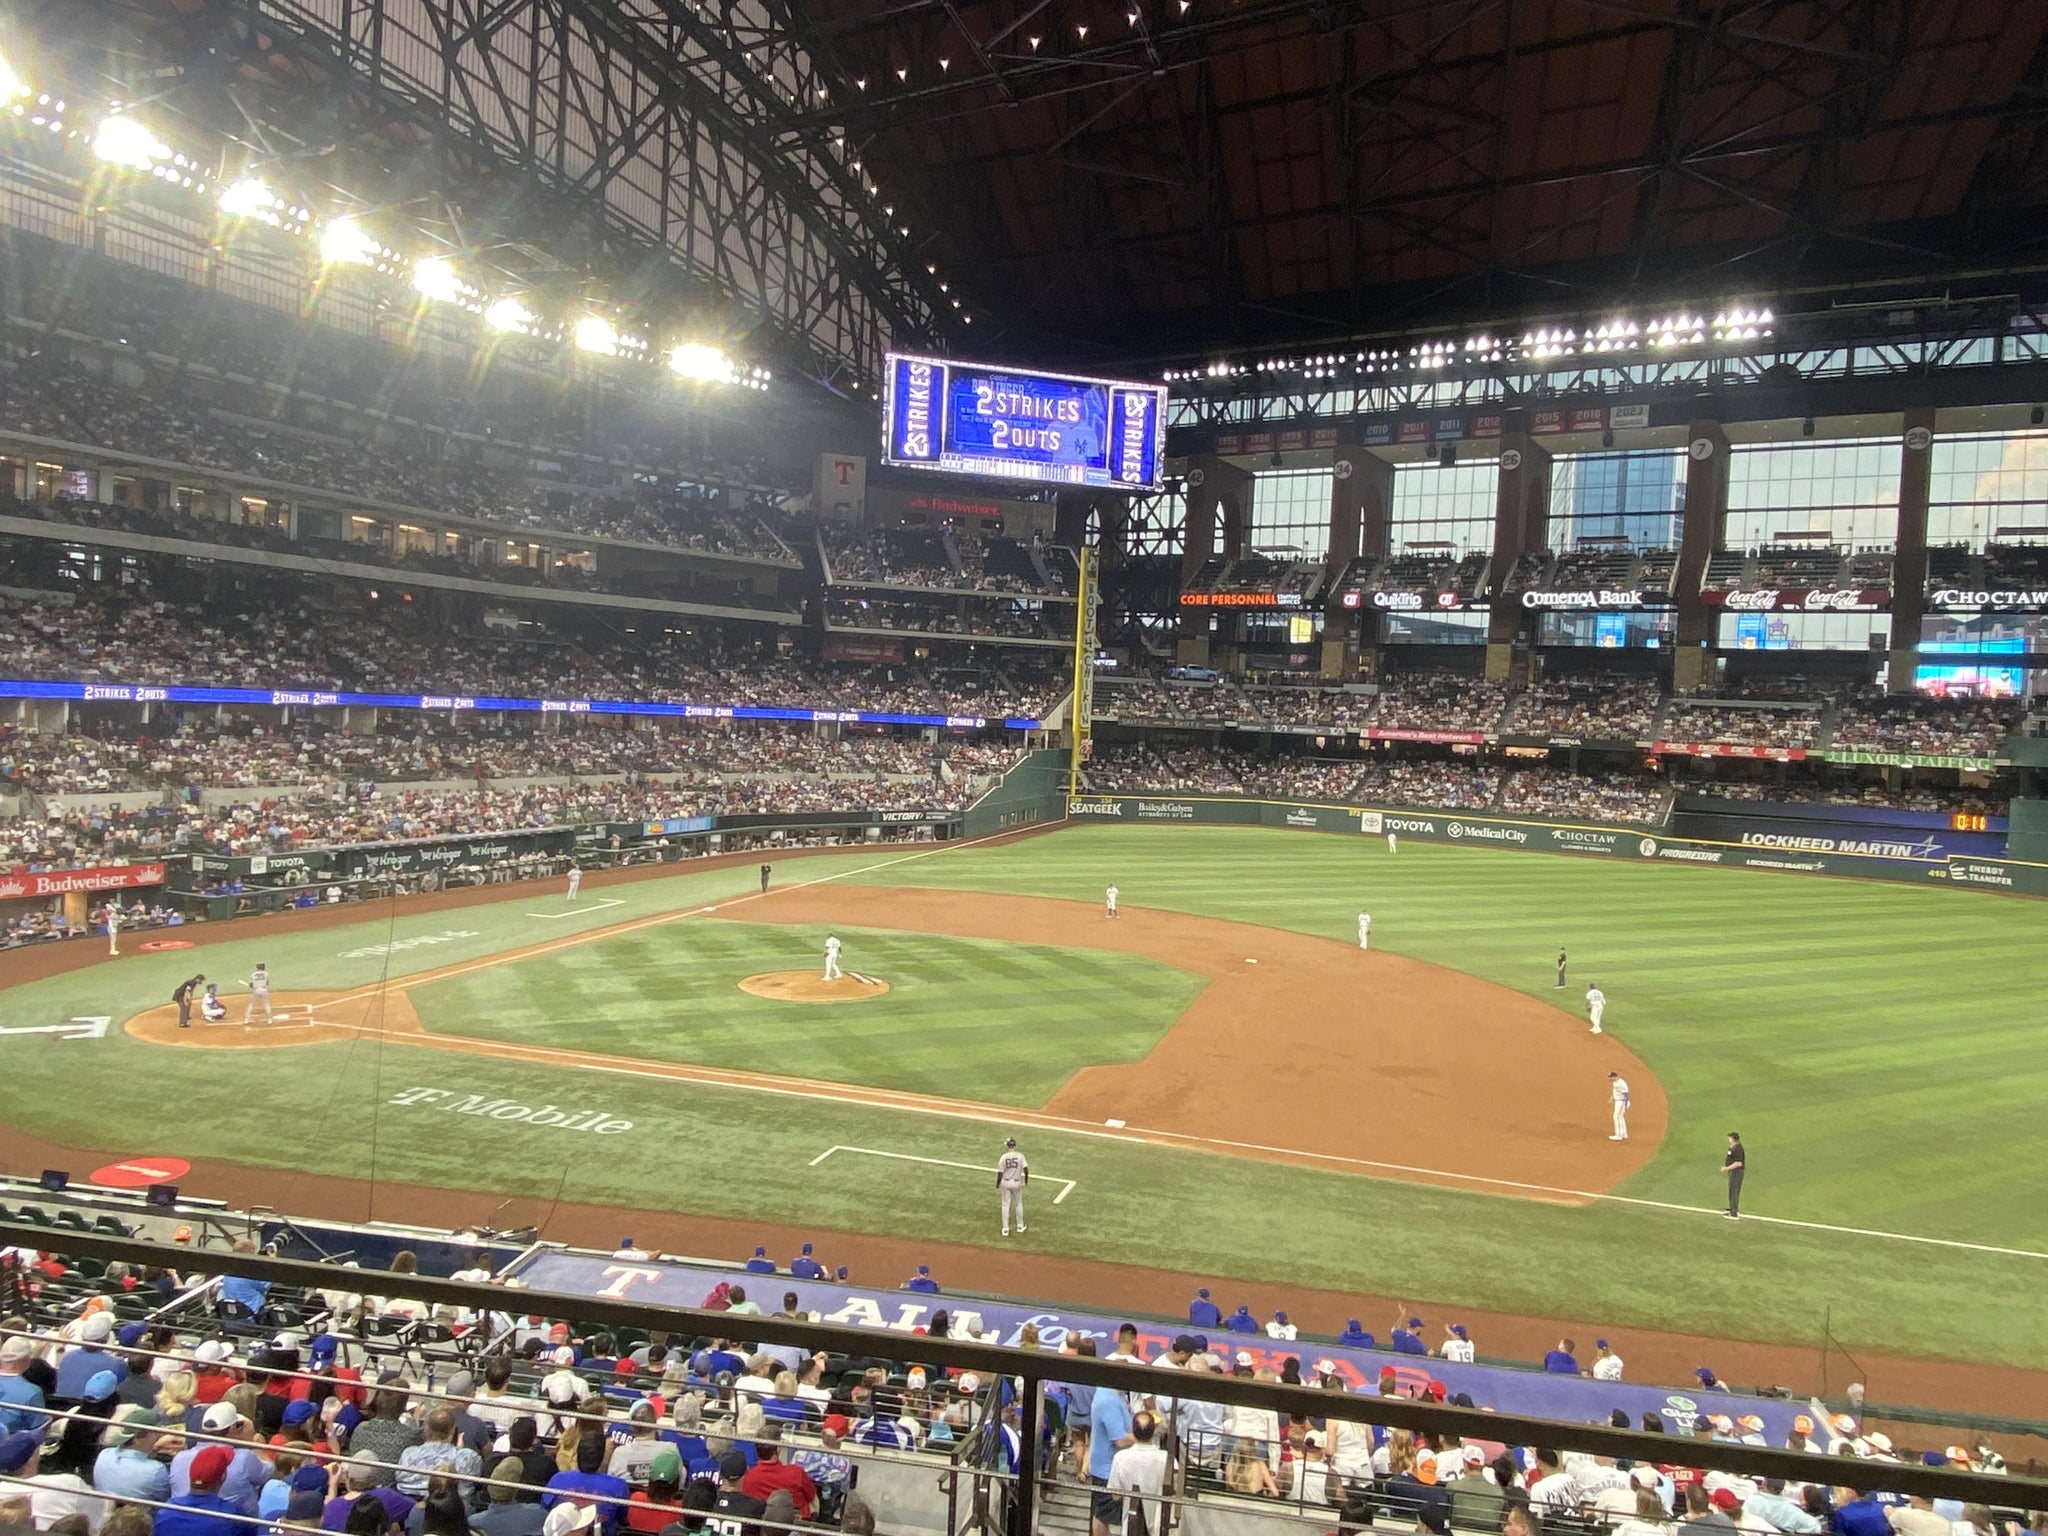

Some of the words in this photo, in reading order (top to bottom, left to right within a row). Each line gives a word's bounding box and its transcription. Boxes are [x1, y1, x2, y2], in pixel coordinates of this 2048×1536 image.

[907, 363, 931, 445] STRIKES
[977, 386, 993, 414] 2
[996, 393, 1080, 422] STRIKES
[1440, 419, 1460, 430] 2011
[1535, 412, 1559, 423] 2015
[1404, 422, 1424, 432] 2011
[992, 420, 1008, 448] 2
[1011, 428, 1061, 450] OUTS
[1122, 406, 1144, 483] STRIKES
[1697, 442, 1707, 456] 7
[1502, 454, 1519, 466] 26
[835, 461, 855, 485] T
[931, 498, 1000, 516] Budweiser
[1180, 594, 1209, 605] CORE
[1211, 594, 1277, 605] PERSONNEL
[1374, 592, 1422, 607] QuikTrip
[1600, 590, 1643, 605] Bank
[1943, 589, 2048, 605] CHOCTAW
[85, 686, 93, 700] 2
[94, 688, 131, 699] STRIKES
[135, 688, 144, 701] 2
[145, 690, 166, 699] OUTS
[273, 692, 280, 705] 2
[313, 693, 320, 705] 2
[422, 696, 428, 708] 2
[454, 698, 460, 709] 2
[570, 702, 576, 712] 2
[1549, 737, 1581, 746] ARENA
[1843, 752, 1900, 766] LUXOR
[1904, 755, 1991, 771] STAFFING
[882, 812, 920, 821] VICTORY
[1069, 803, 1122, 815] SEATGEEK
[1385, 819, 1434, 833] TOYOTA
[1464, 826, 1504, 840] Medical
[1506, 829, 1528, 844] City
[1560, 830, 1617, 844] CHOCTAW
[1742, 833, 1836, 852] LOCKHEED
[1839, 840, 1912, 857] MARTIN
[379, 851, 412, 870] Kroger
[432, 845, 463, 864] Kroger
[1659, 848, 1722, 863] PROGRESSIVE
[269, 857, 305, 868] TOYOTA
[1746, 859, 1783, 868] LOCKHEED
[1784, 862, 1813, 870] MARTIN
[1969, 865, 2004, 876] ENERGY
[36, 874, 127, 893] Budweiser
[1969, 874, 2012, 885] TRANSFER
[388, 1087, 634, 1134] T-Mobile
[1005, 1157, 1018, 1169] 85
[596, 1266, 663, 1297] T
[1003, 1314, 1107, 1351] for
